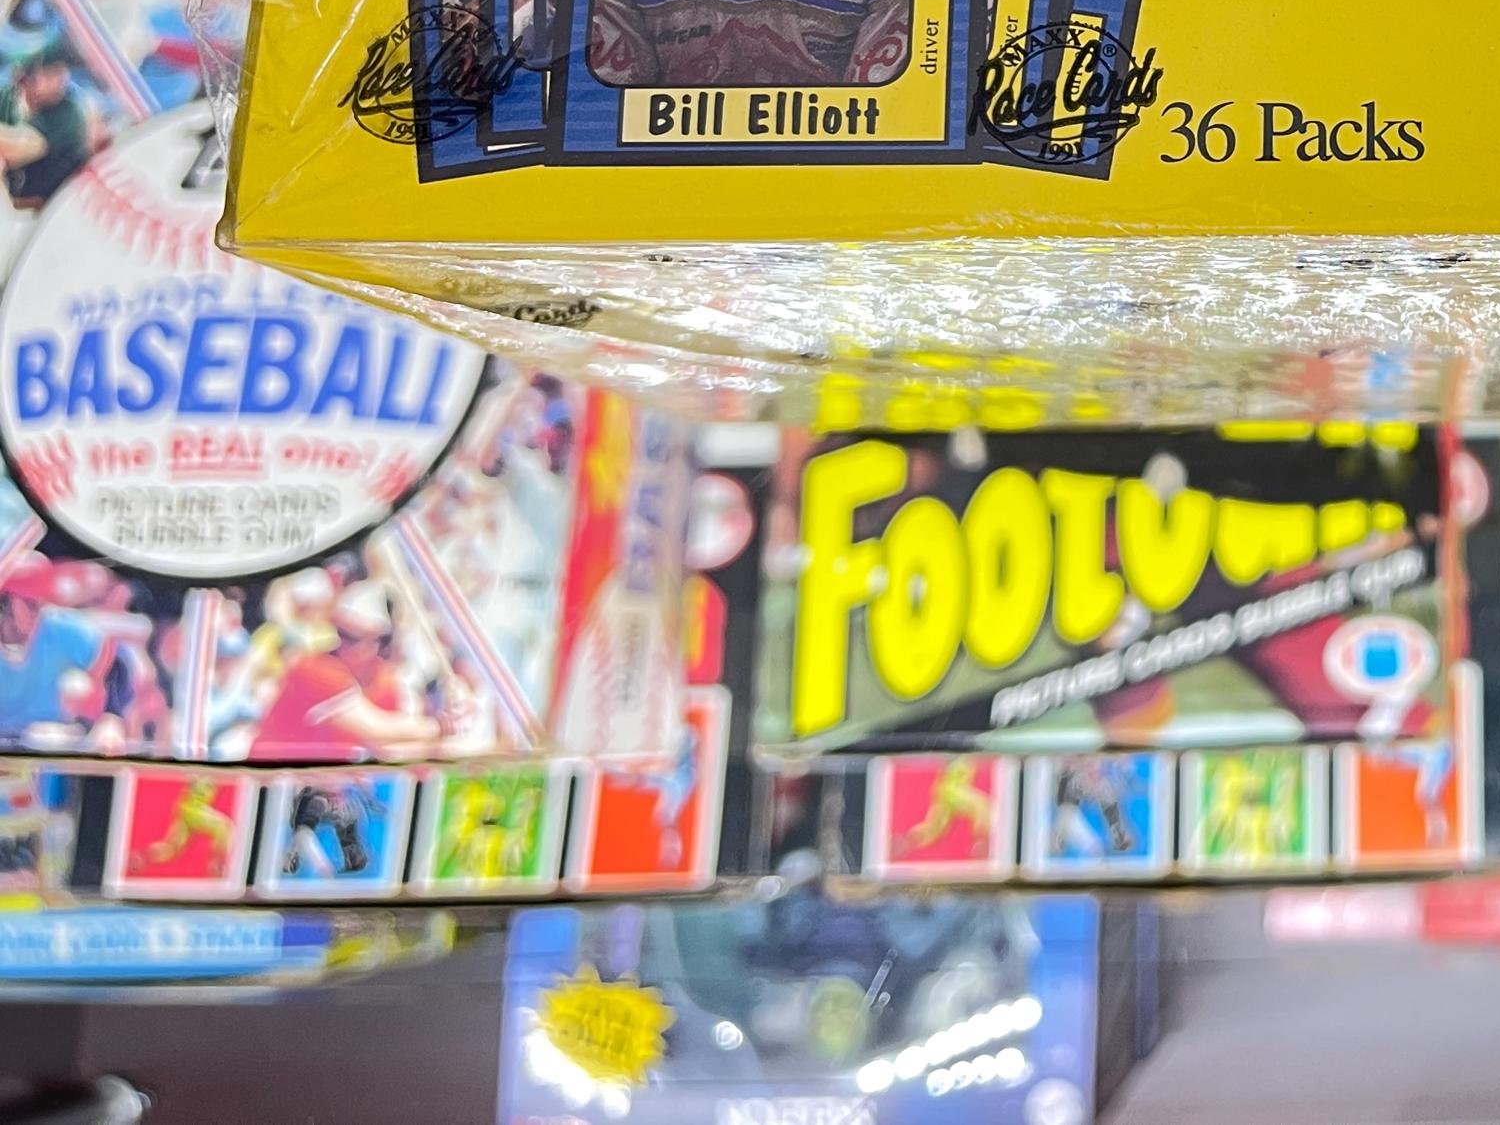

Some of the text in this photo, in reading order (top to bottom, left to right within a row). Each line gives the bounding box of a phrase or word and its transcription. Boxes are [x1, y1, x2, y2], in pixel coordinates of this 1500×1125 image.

[919, 18, 941, 75] driver
[1002, 28, 1085, 68] MAXX
[648, 90, 880, 136] Bill Elliott
[967, 57, 1057, 136] Race
[1063, 39, 1165, 113] Cards
[1037, 140, 1085, 160] 1991
[1160, 100, 1426, 163] 36 Packs
